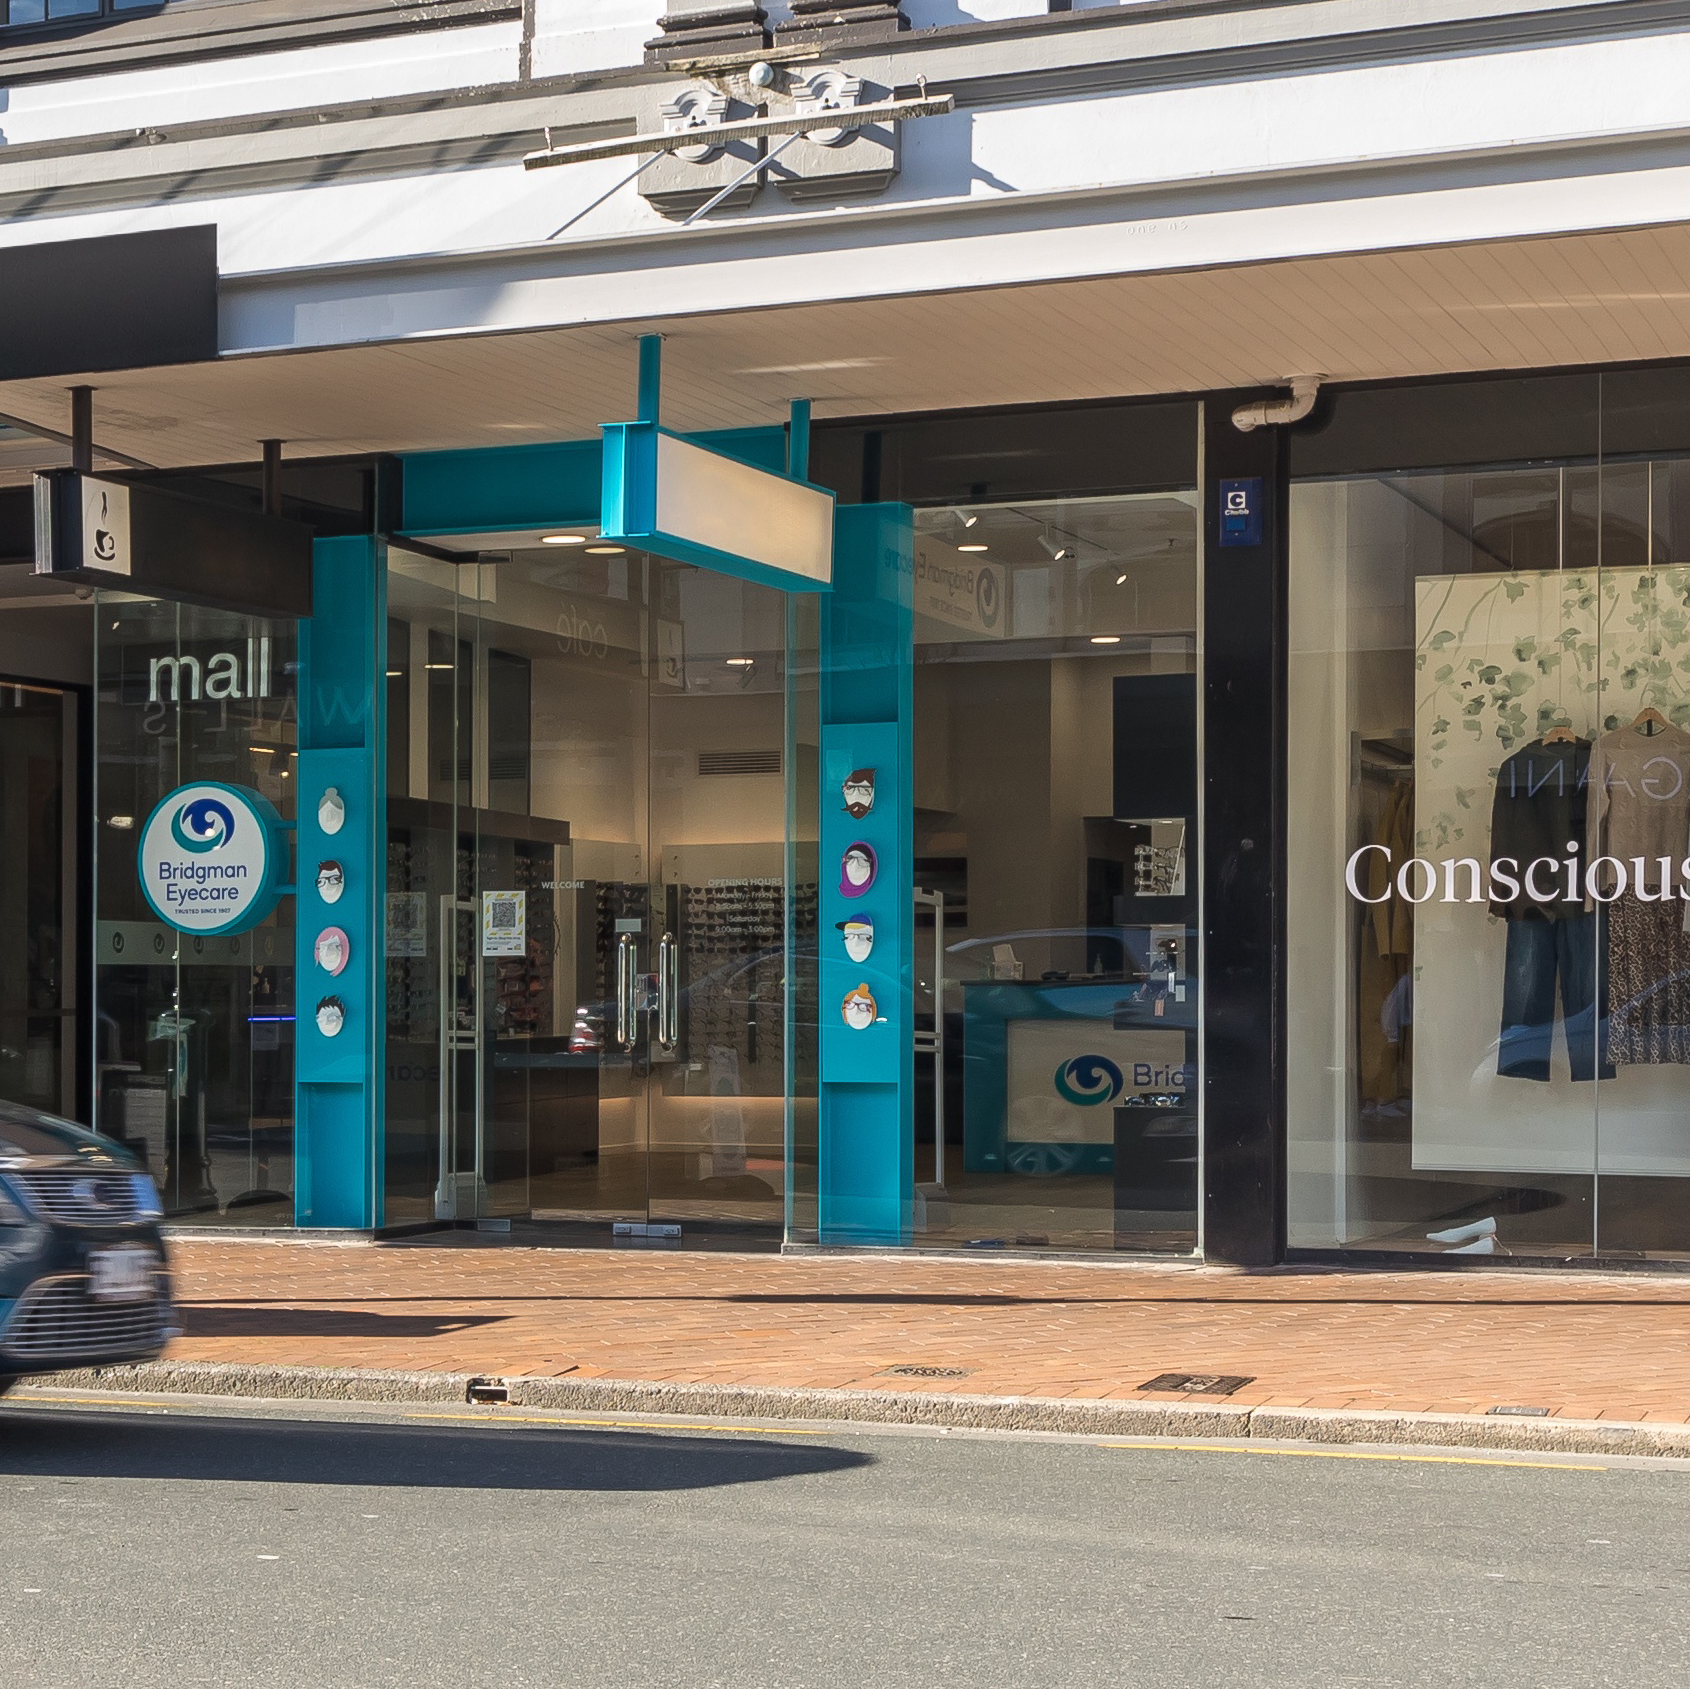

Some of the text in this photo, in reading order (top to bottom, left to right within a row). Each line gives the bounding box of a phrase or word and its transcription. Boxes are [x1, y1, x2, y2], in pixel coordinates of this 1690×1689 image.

[149, 637, 269, 701] mall
[159, 861, 247, 885] Bridgman
[541, 881, 585, 889] WELCOME
[707, 877, 783, 887] OPENING HOURS
[166, 883, 239, 907] Eyecare
